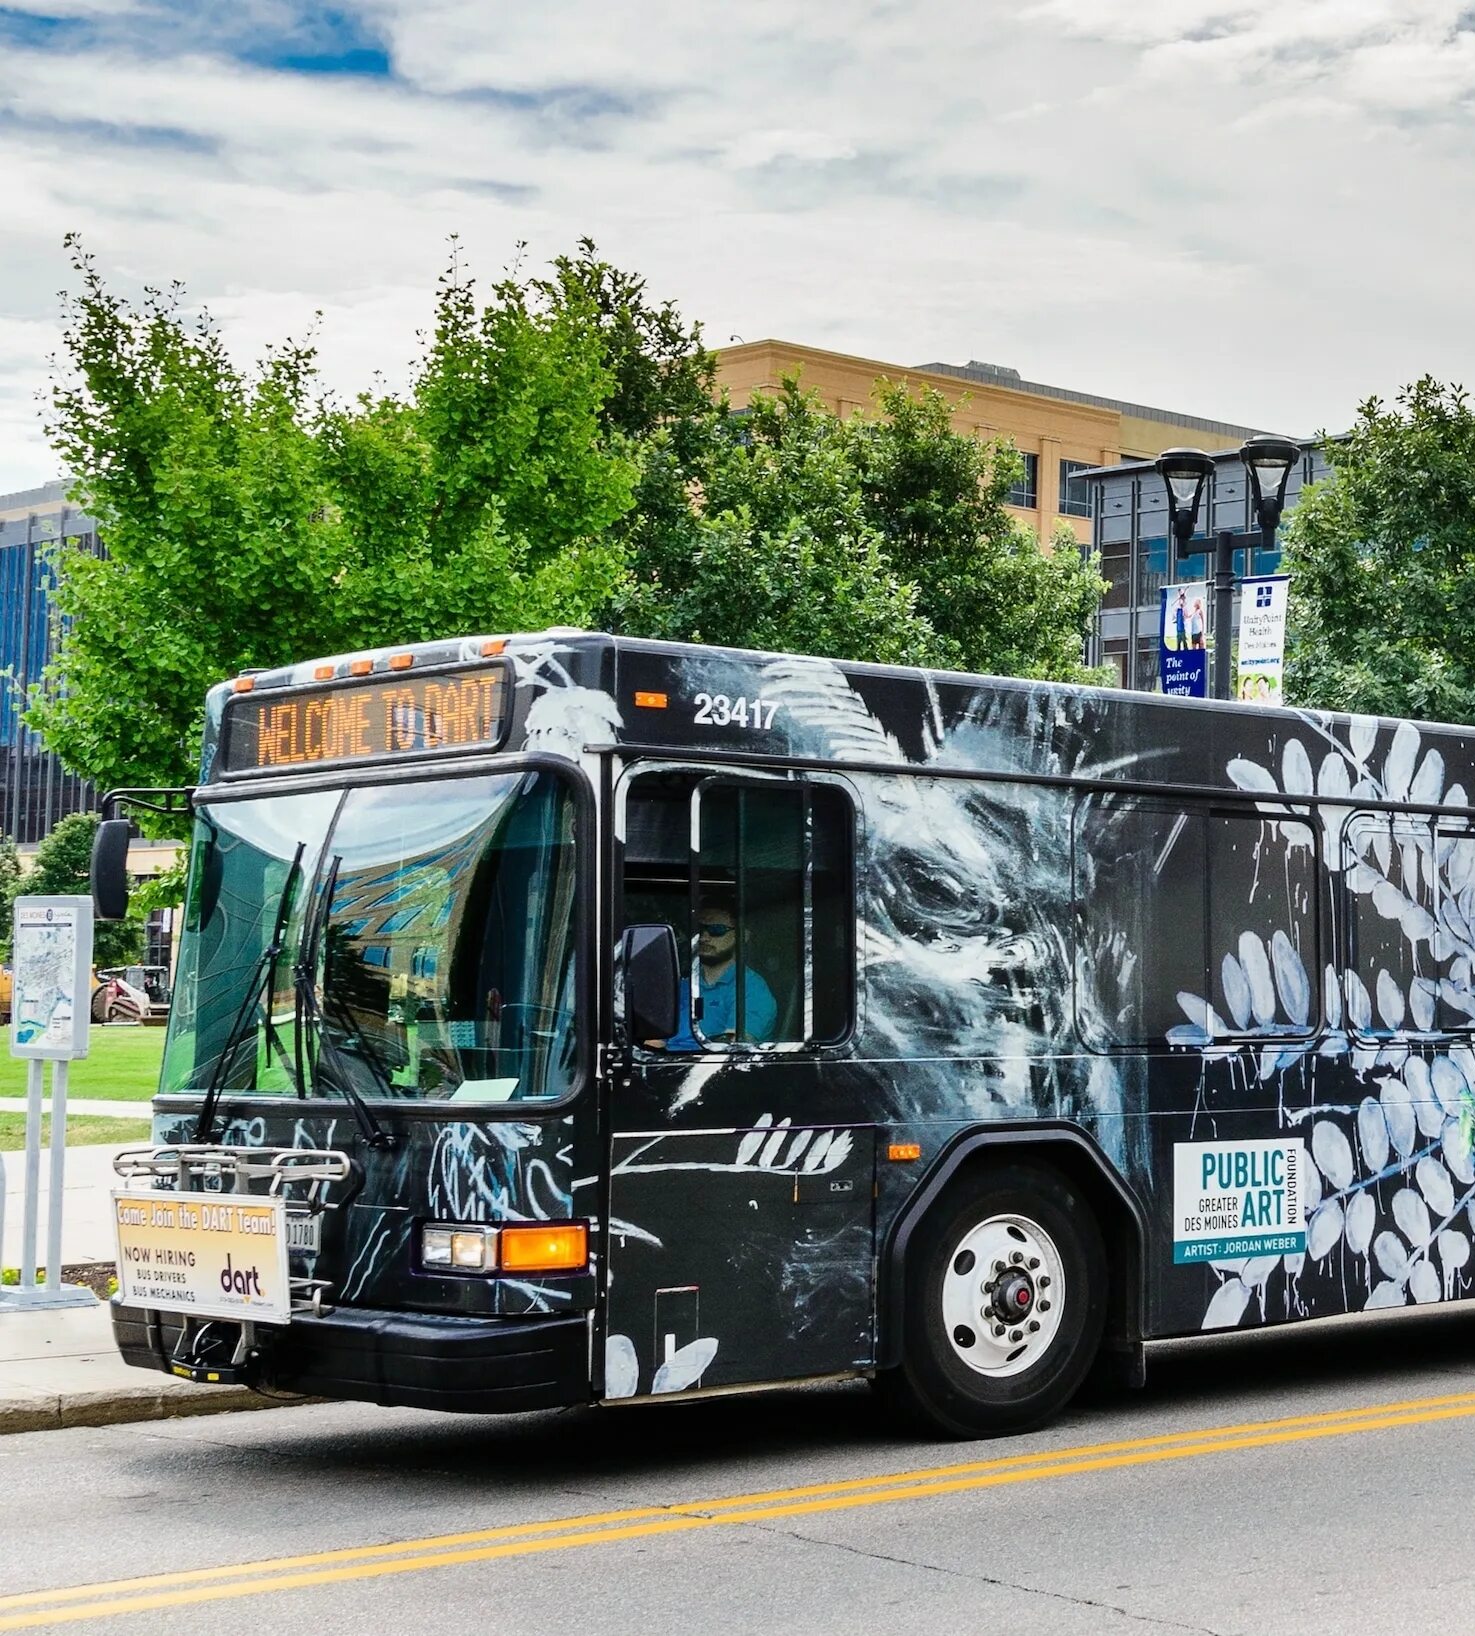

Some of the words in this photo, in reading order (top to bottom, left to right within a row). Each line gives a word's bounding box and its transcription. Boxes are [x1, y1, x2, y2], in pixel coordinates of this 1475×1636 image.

[1166, 657, 1182, 668] The
[1166, 670, 1189, 684] point
[1190, 669, 1201, 682] of
[1167, 684, 1191, 697] unity
[258, 694, 373, 766] WELCOME
[381, 687, 415, 751] TO
[424, 676, 496, 747] DART
[694, 692, 779, 730] 23417
[1202, 1149, 1284, 1190] PUBLIC
[1286, 1148, 1297, 1225] FOUNDATION
[1198, 1196, 1239, 1213] GREATER
[1240, 1189, 1285, 1228] ART
[117, 1200, 147, 1225] Come
[151, 1202, 175, 1228] Join
[178, 1203, 198, 1230] the
[202, 1205, 234, 1232] DART
[237, 1207, 277, 1236] Team!
[1184, 1215, 1202, 1232] DES
[1204, 1214, 1239, 1231] MOINES
[124, 1246, 151, 1263] NOW
[155, 1249, 196, 1267] HIRING
[1184, 1243, 1222, 1258] ARTIST:
[1223, 1240, 1262, 1254] JORDAN
[1263, 1237, 1297, 1250] WEBER
[136, 1269, 151, 1280] BUS
[153, 1270, 186, 1284] DRIVERS
[221, 1252, 262, 1296] dart
[132, 1285, 147, 1297] BUS
[149, 1287, 196, 1303] MECHANICS
